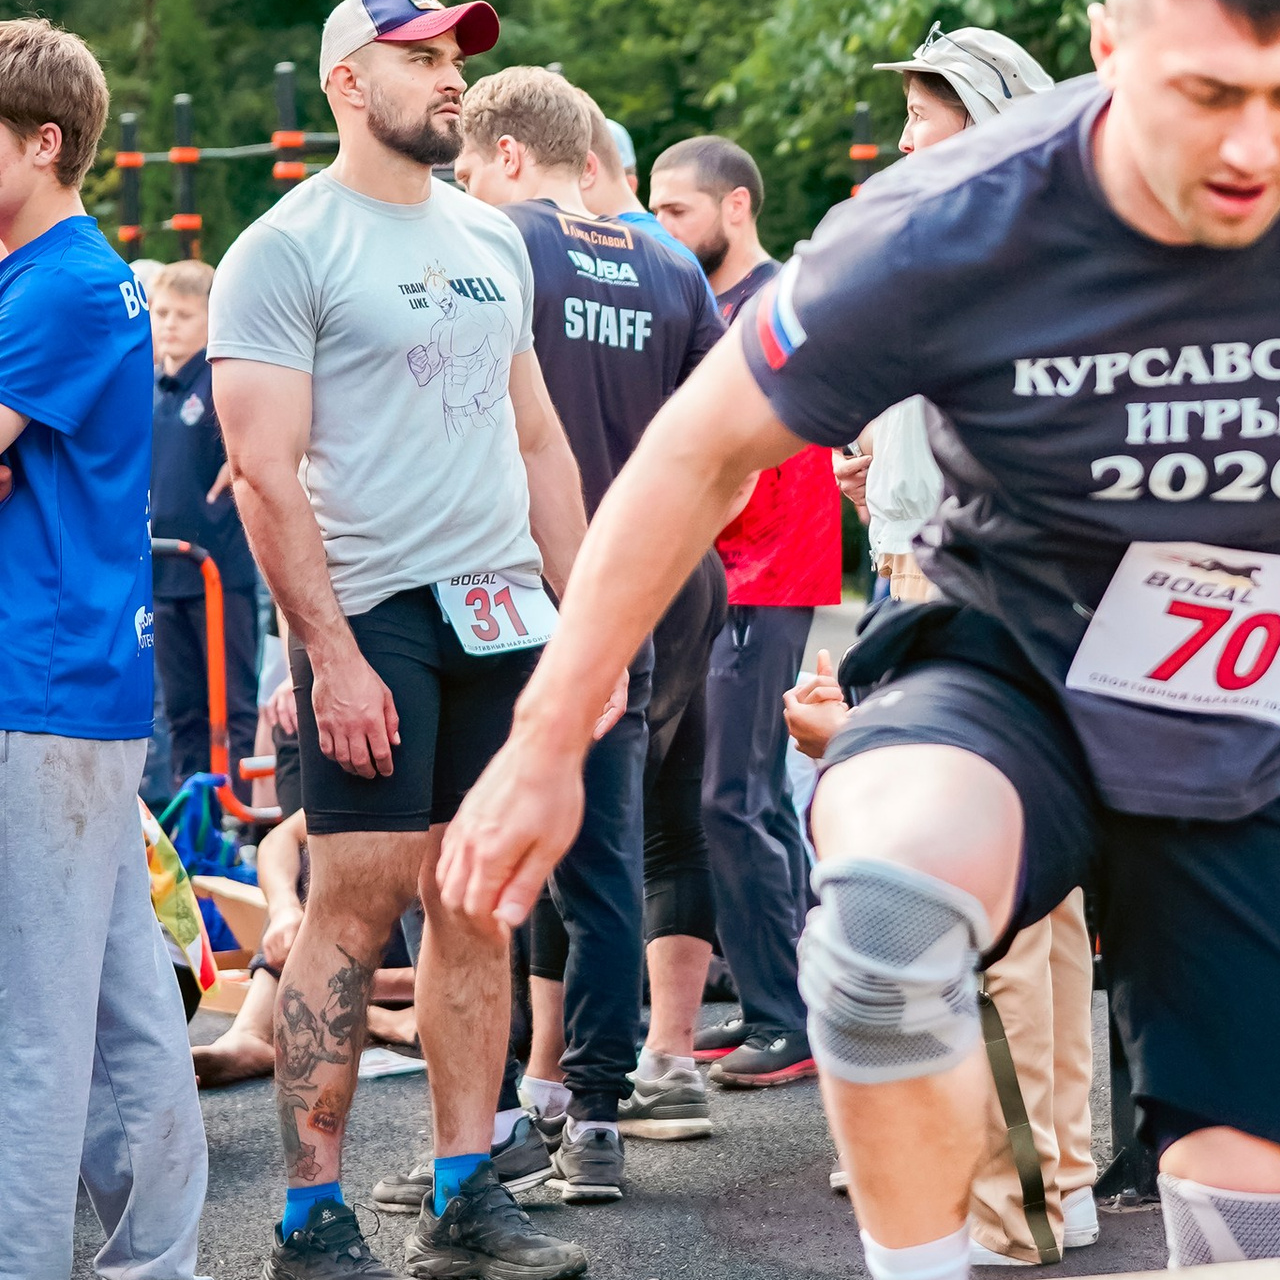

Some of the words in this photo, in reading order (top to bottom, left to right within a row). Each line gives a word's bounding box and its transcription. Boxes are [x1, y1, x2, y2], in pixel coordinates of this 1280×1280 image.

[596, 257, 639, 282] IBA
[398, 282, 427, 296] TRAIN
[448, 277, 506, 303] HELL
[409, 297, 430, 310] LIKE
[564, 297, 652, 351] STAFF
[450, 573, 497, 587] BOGAL
[1145, 570, 1256, 605] BOGAL
[465, 585, 529, 641] 31
